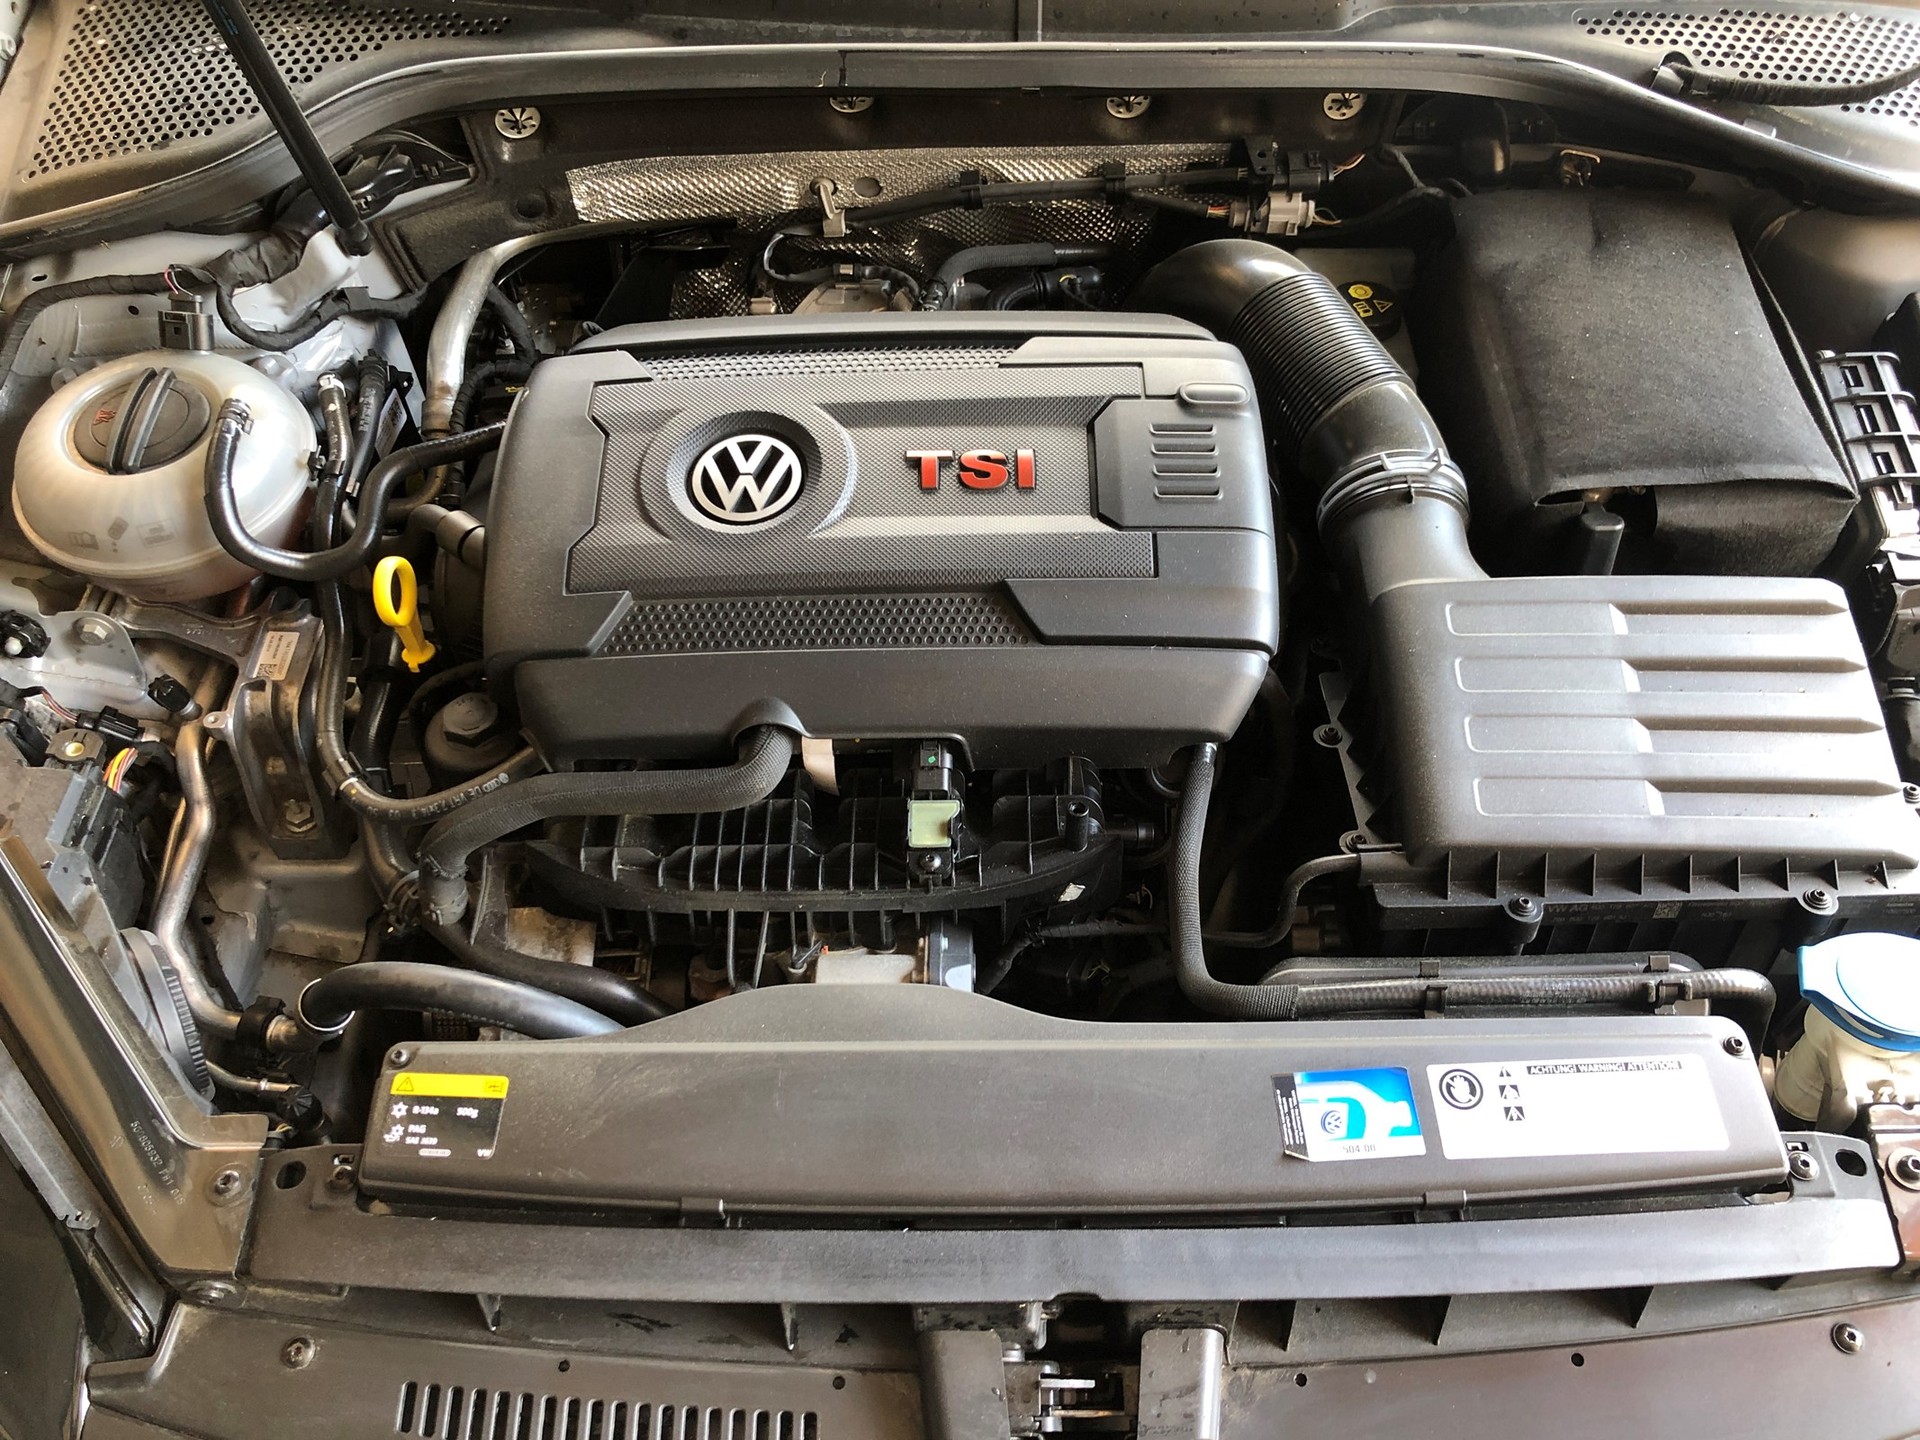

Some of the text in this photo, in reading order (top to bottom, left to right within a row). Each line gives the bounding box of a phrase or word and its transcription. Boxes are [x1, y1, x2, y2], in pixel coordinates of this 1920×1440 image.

[691, 433, 803, 522] VW
[905, 448, 1036, 491] TSI
[1529, 1061, 1679, 1075] ACHTUNG! WARNING! ATTENTION!
[408, 1124, 427, 1134] PAG
